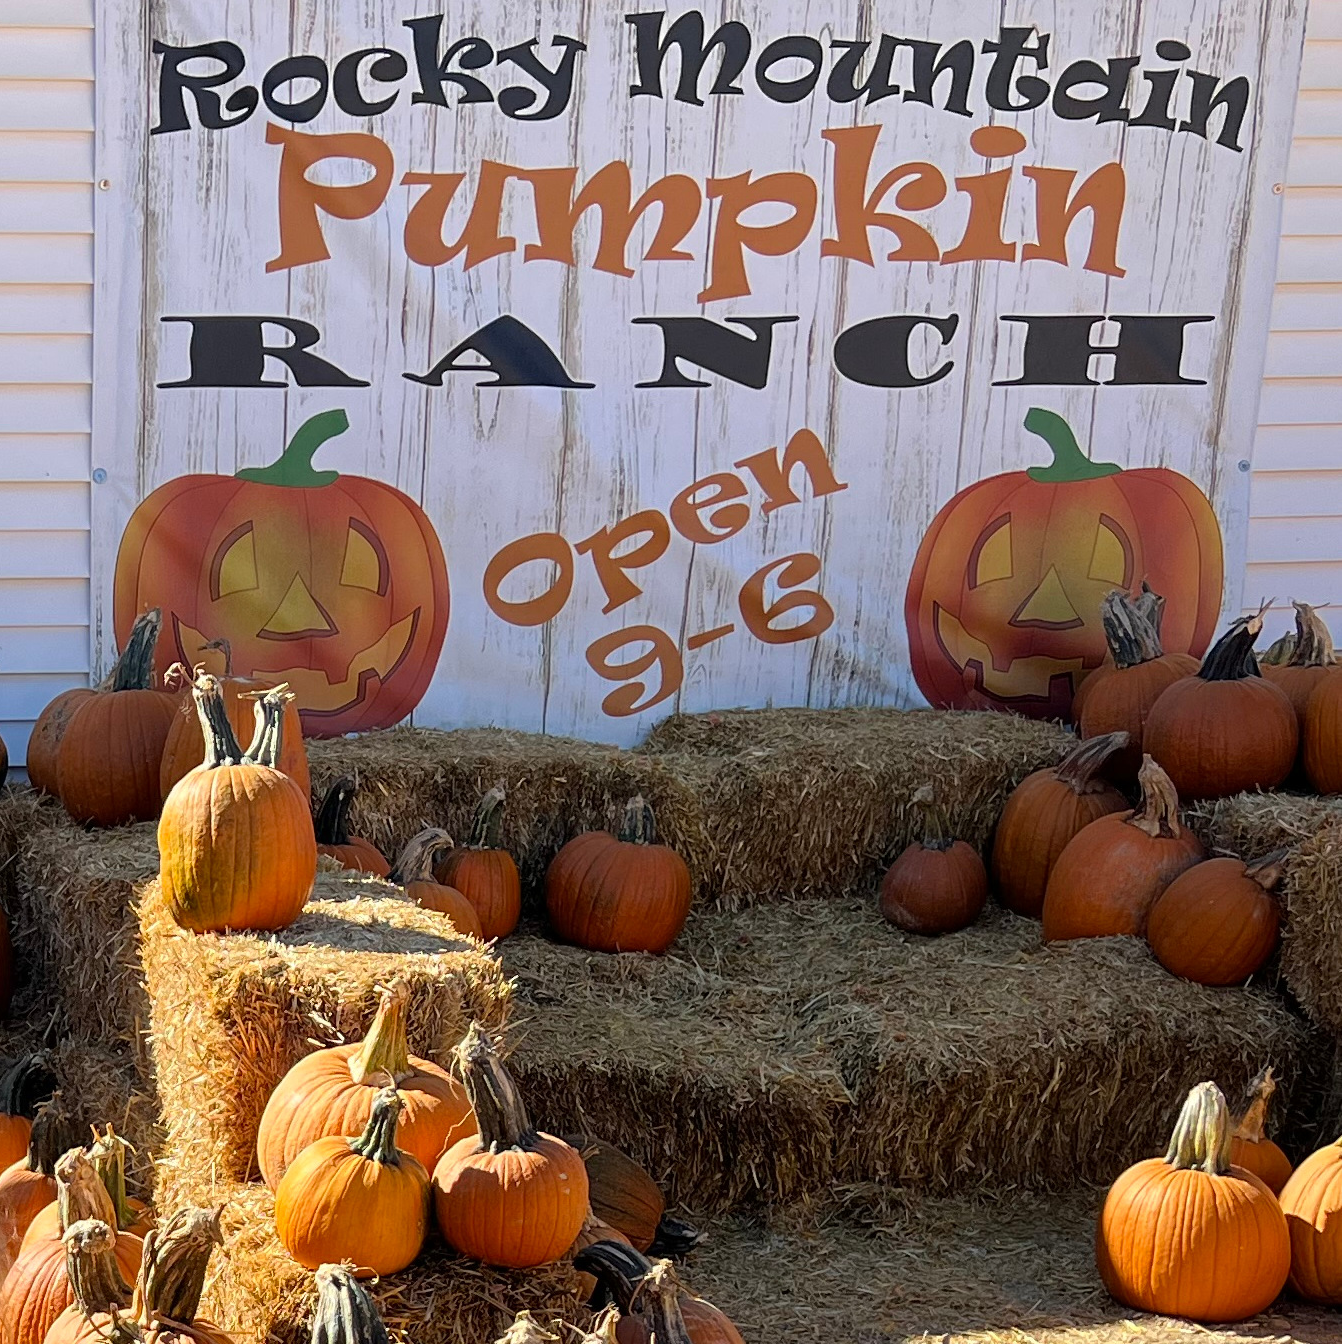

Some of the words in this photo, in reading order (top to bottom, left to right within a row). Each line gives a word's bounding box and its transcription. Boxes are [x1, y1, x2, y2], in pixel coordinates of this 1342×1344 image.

[150, 13, 589, 136] Rocky
[624, 10, 1250, 153] Mountain
[265, 123, 1127, 303] Pumpkin
[156, 314, 1217, 389] RANCH
[482, 428, 847, 626] Open
[586, 553, 834, 716] 9-6
